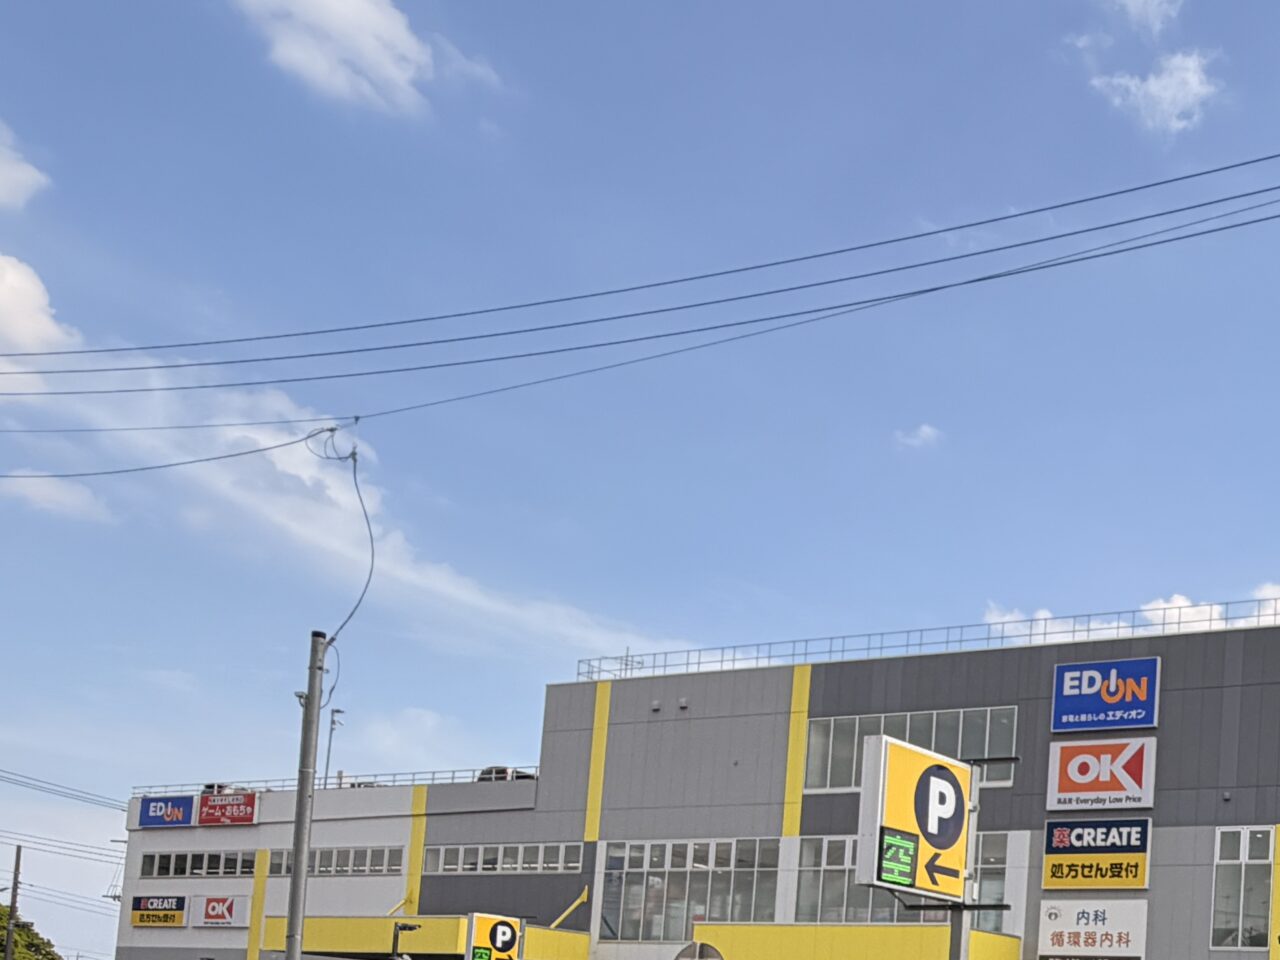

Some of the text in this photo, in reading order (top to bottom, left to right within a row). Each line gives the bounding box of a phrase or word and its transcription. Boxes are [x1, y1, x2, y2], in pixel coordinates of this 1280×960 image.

[1063, 668, 1148, 703] EDION
[1067, 743, 1143, 791] OK
[927, 776, 956, 835] P
[1109, 796, 1123, 804] Low
[1125, 795, 1142, 803] Price
[149, 802, 184, 821] EDION
[881, 835, 915, 886] 空
[1050, 862, 1139, 879] 処方せん受付
[207, 898, 234, 920] OK
[1076, 909, 1108, 926] 内科
[496, 925, 512, 948] P
[1050, 930, 1131, 948] 循環器内科
